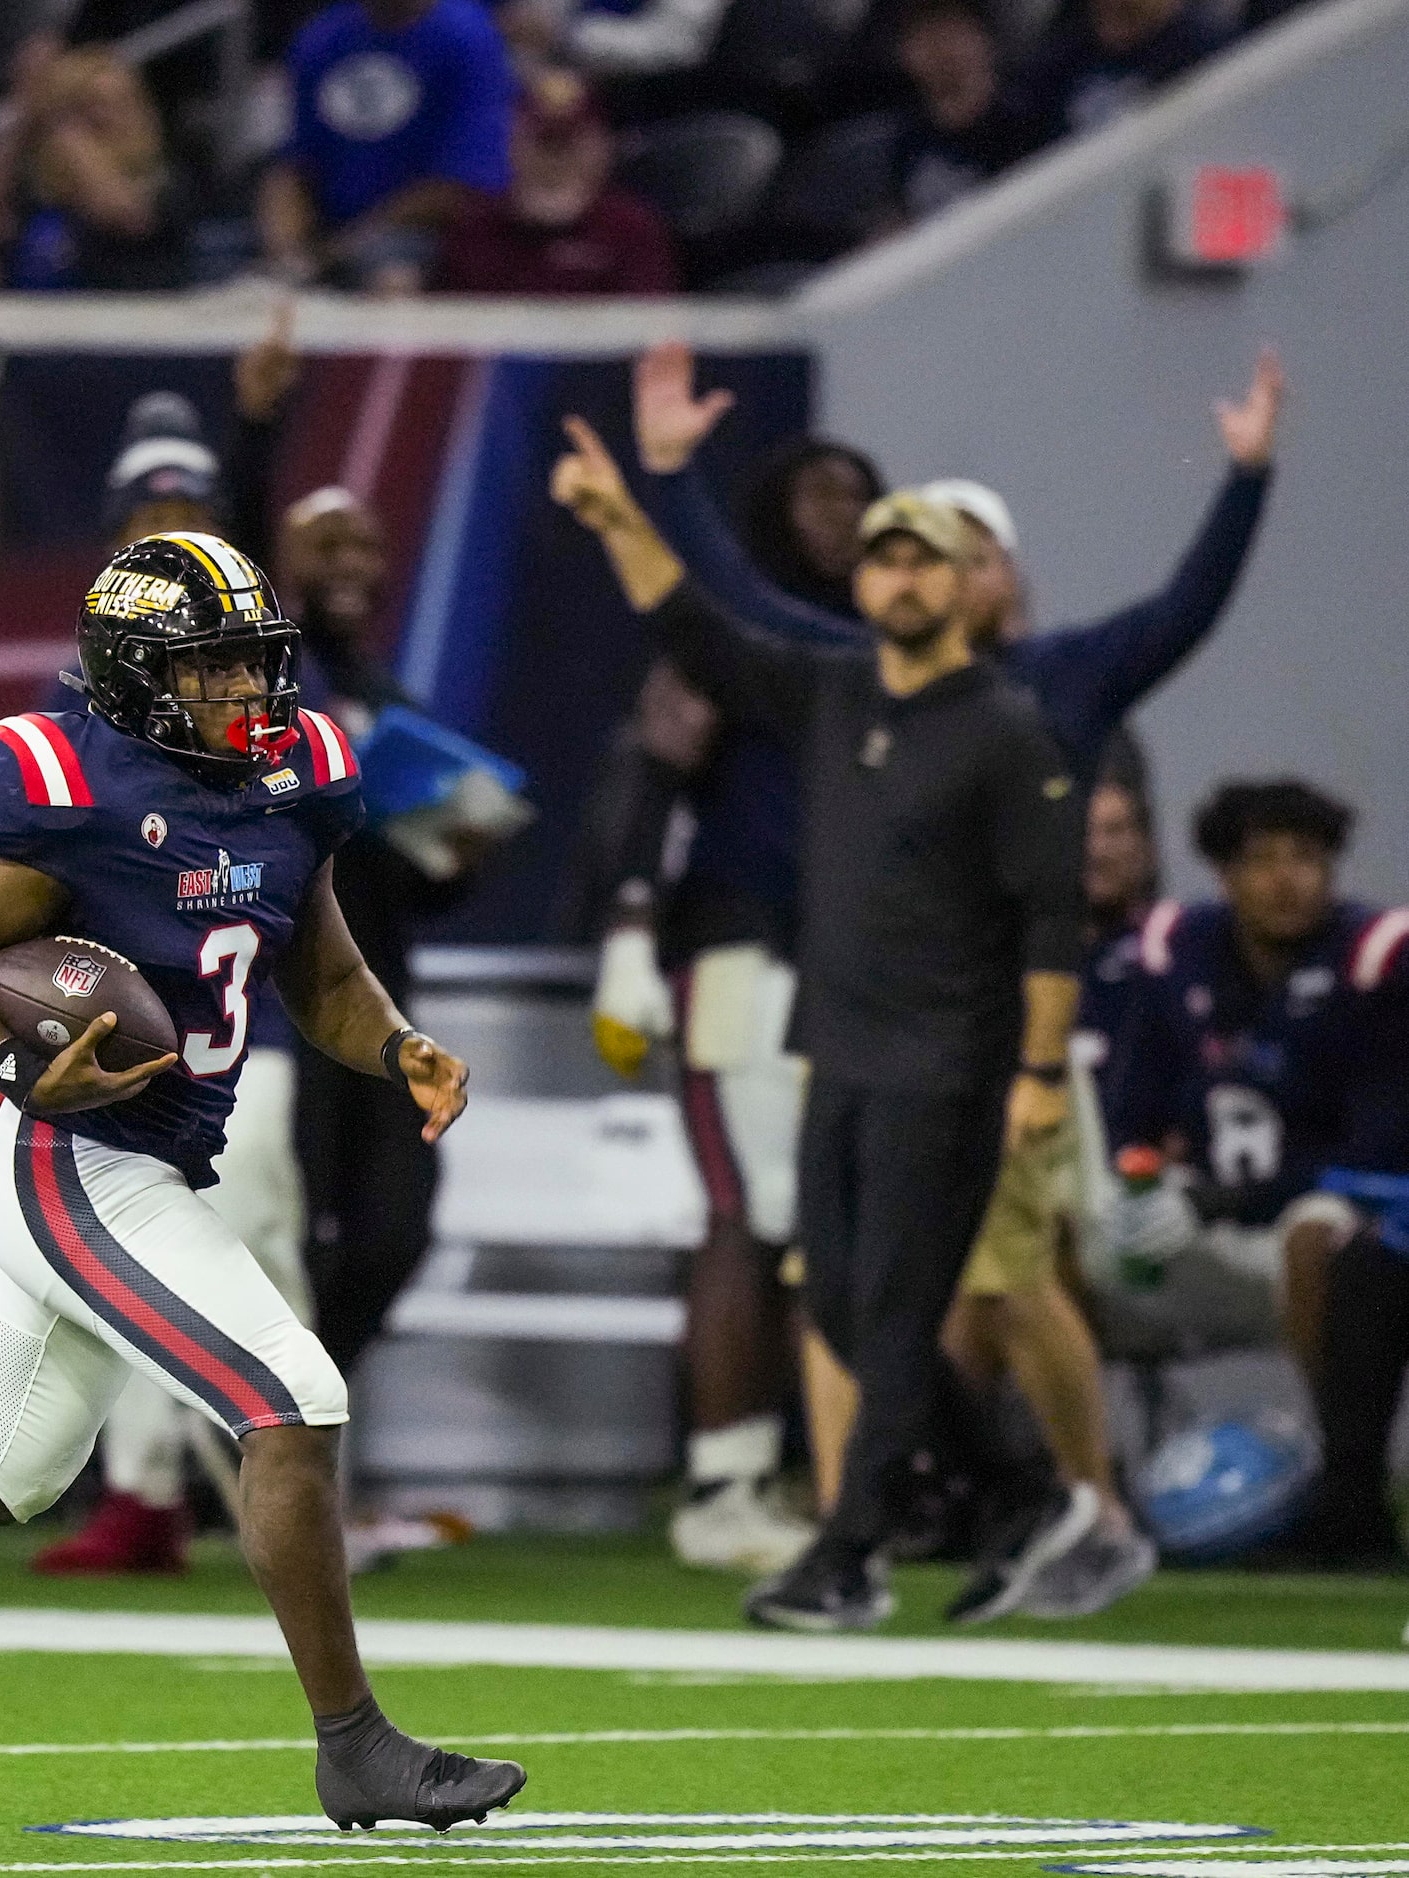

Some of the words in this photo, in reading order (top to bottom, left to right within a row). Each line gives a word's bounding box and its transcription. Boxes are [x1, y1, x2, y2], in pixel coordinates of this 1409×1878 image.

[88, 565, 186, 608] SOUTHERN
[94, 592, 134, 619] MISS
[177, 869, 212, 898] EAST
[230, 863, 264, 893] WEST
[176, 896, 225, 911] SHRINE
[58, 965, 92, 991] NFL
[181, 919, 262, 1080] 3
